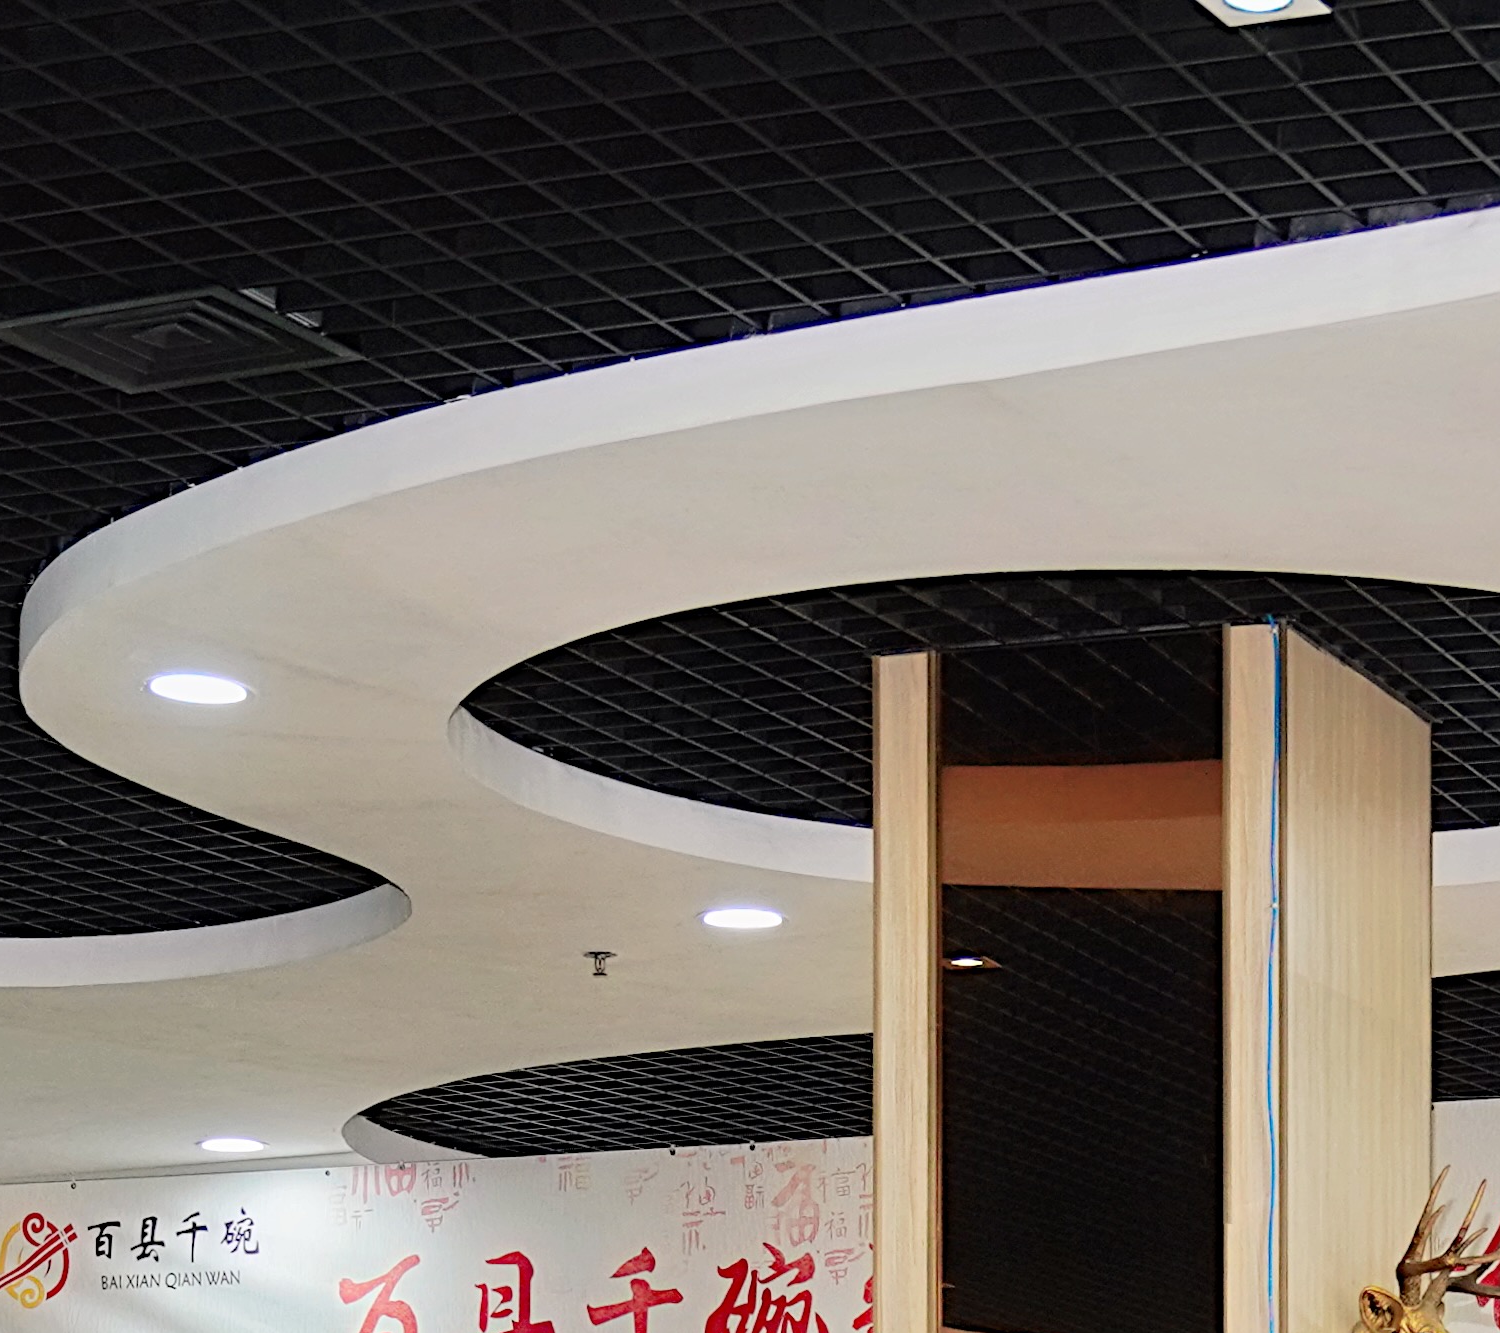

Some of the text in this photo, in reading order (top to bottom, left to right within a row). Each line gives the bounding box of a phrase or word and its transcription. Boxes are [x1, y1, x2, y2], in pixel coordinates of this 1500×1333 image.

[88, 1207, 259, 1262] 百县千碗
[101, 1270, 241, 1290] BAI XIAN QIAN WAN
